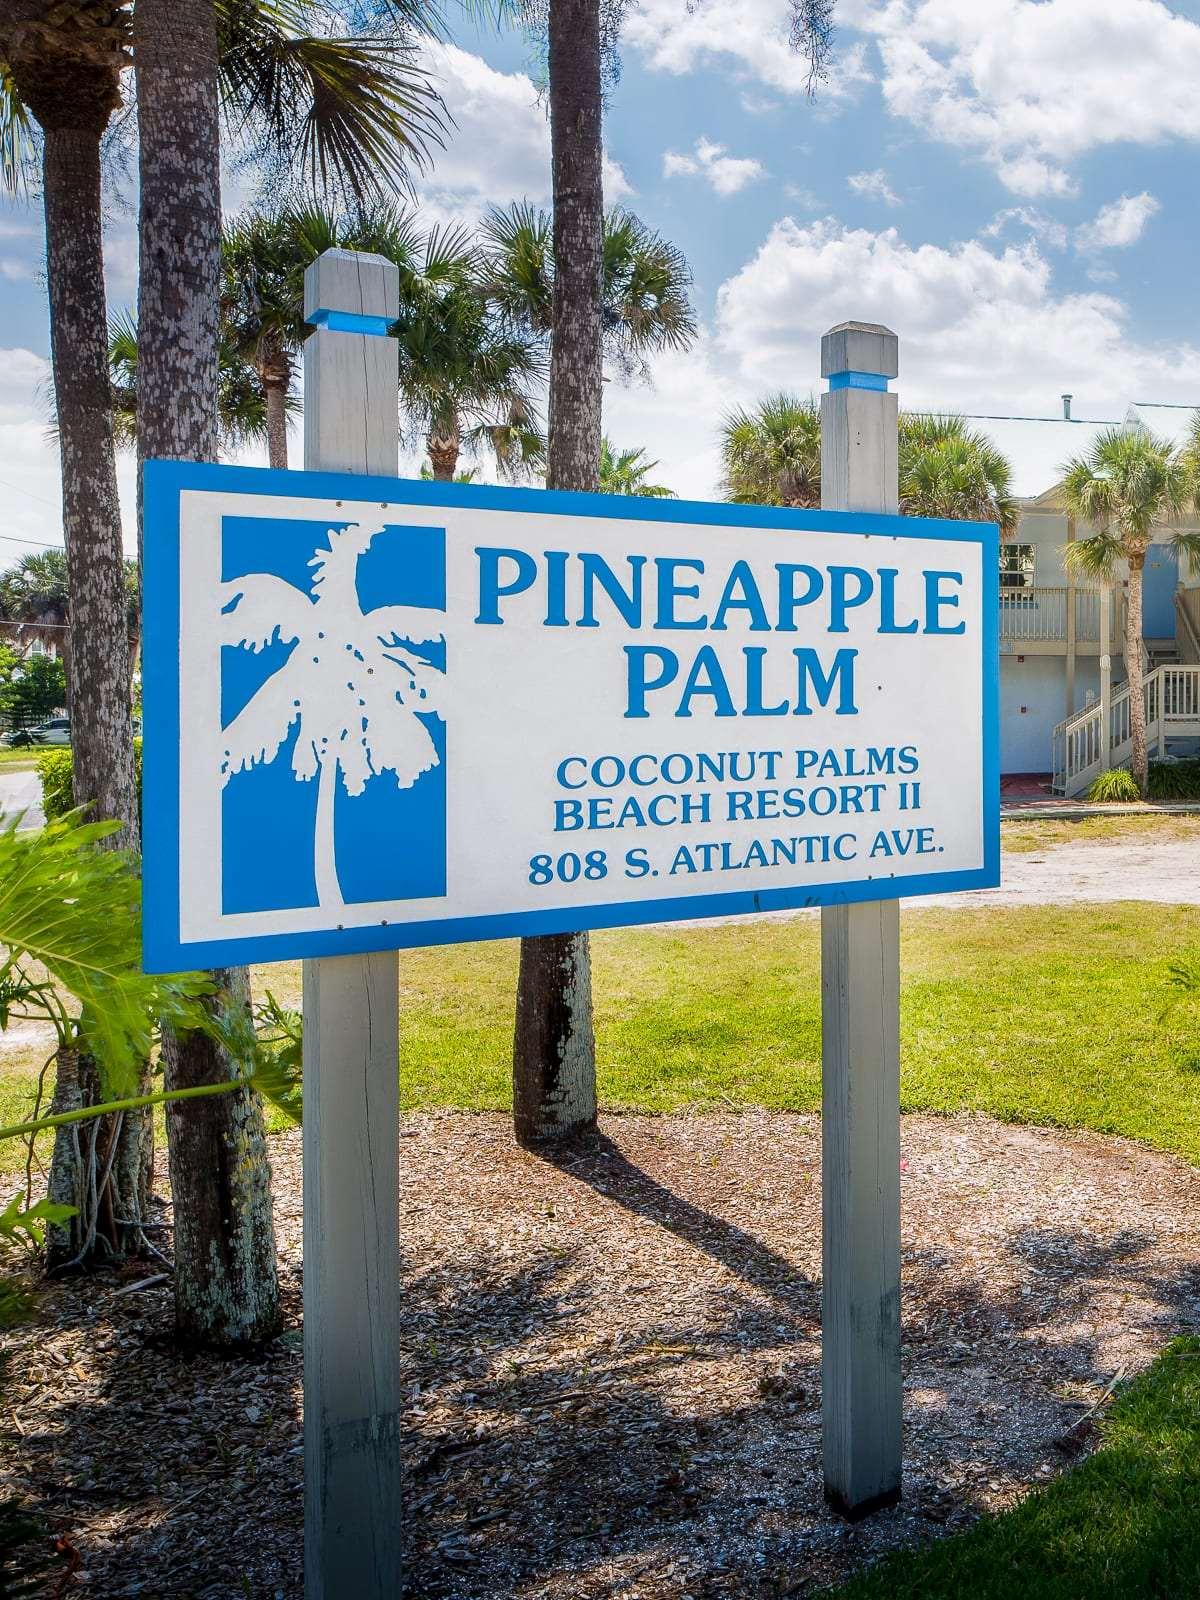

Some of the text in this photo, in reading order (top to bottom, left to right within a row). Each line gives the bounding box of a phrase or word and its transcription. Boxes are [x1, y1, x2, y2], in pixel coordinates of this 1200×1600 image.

[473, 546, 966, 636] PINEAPPLE
[622, 645, 860, 719] PALM
[556, 746, 919, 790] COCONUT PALMS
[553, 782, 921, 832] BEACH RESORT II
[528, 827, 945, 886] 808 S. ATLANTIC AVE.
